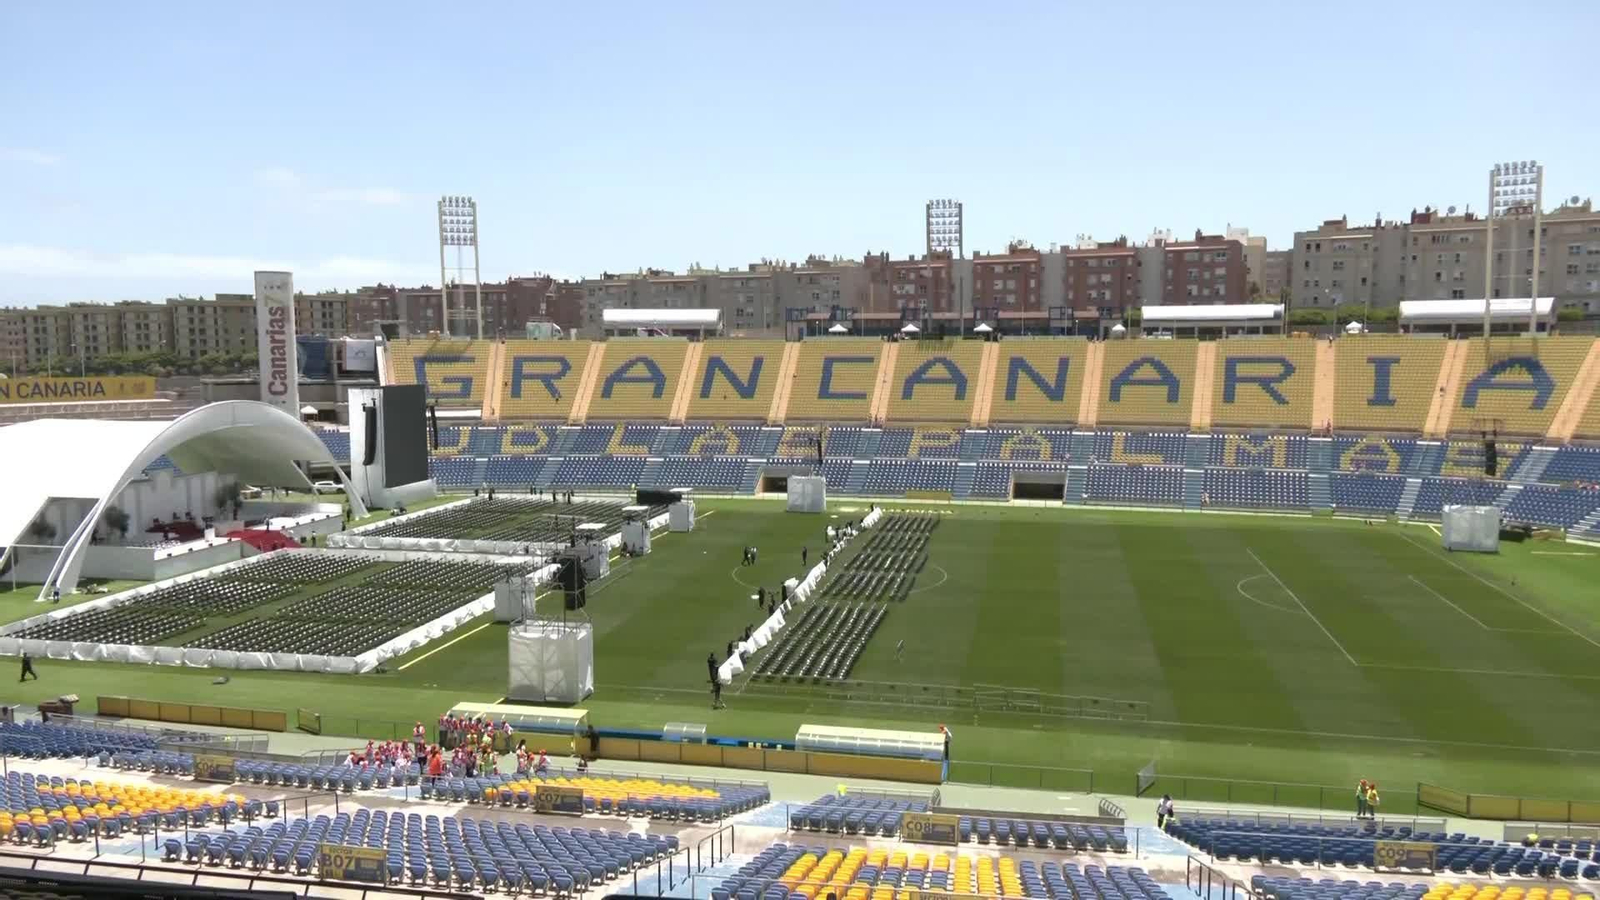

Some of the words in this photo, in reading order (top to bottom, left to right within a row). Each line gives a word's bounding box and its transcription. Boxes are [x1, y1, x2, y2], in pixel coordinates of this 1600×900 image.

[267, 306, 288, 396] Canarias
[16, 381, 106, 398] CANARIA
[413, 355, 764, 399] GRAN
[818, 355, 1556, 410] CANARIA
[906, 821, 930, 833] C08
[319, 853, 354, 869] B07
